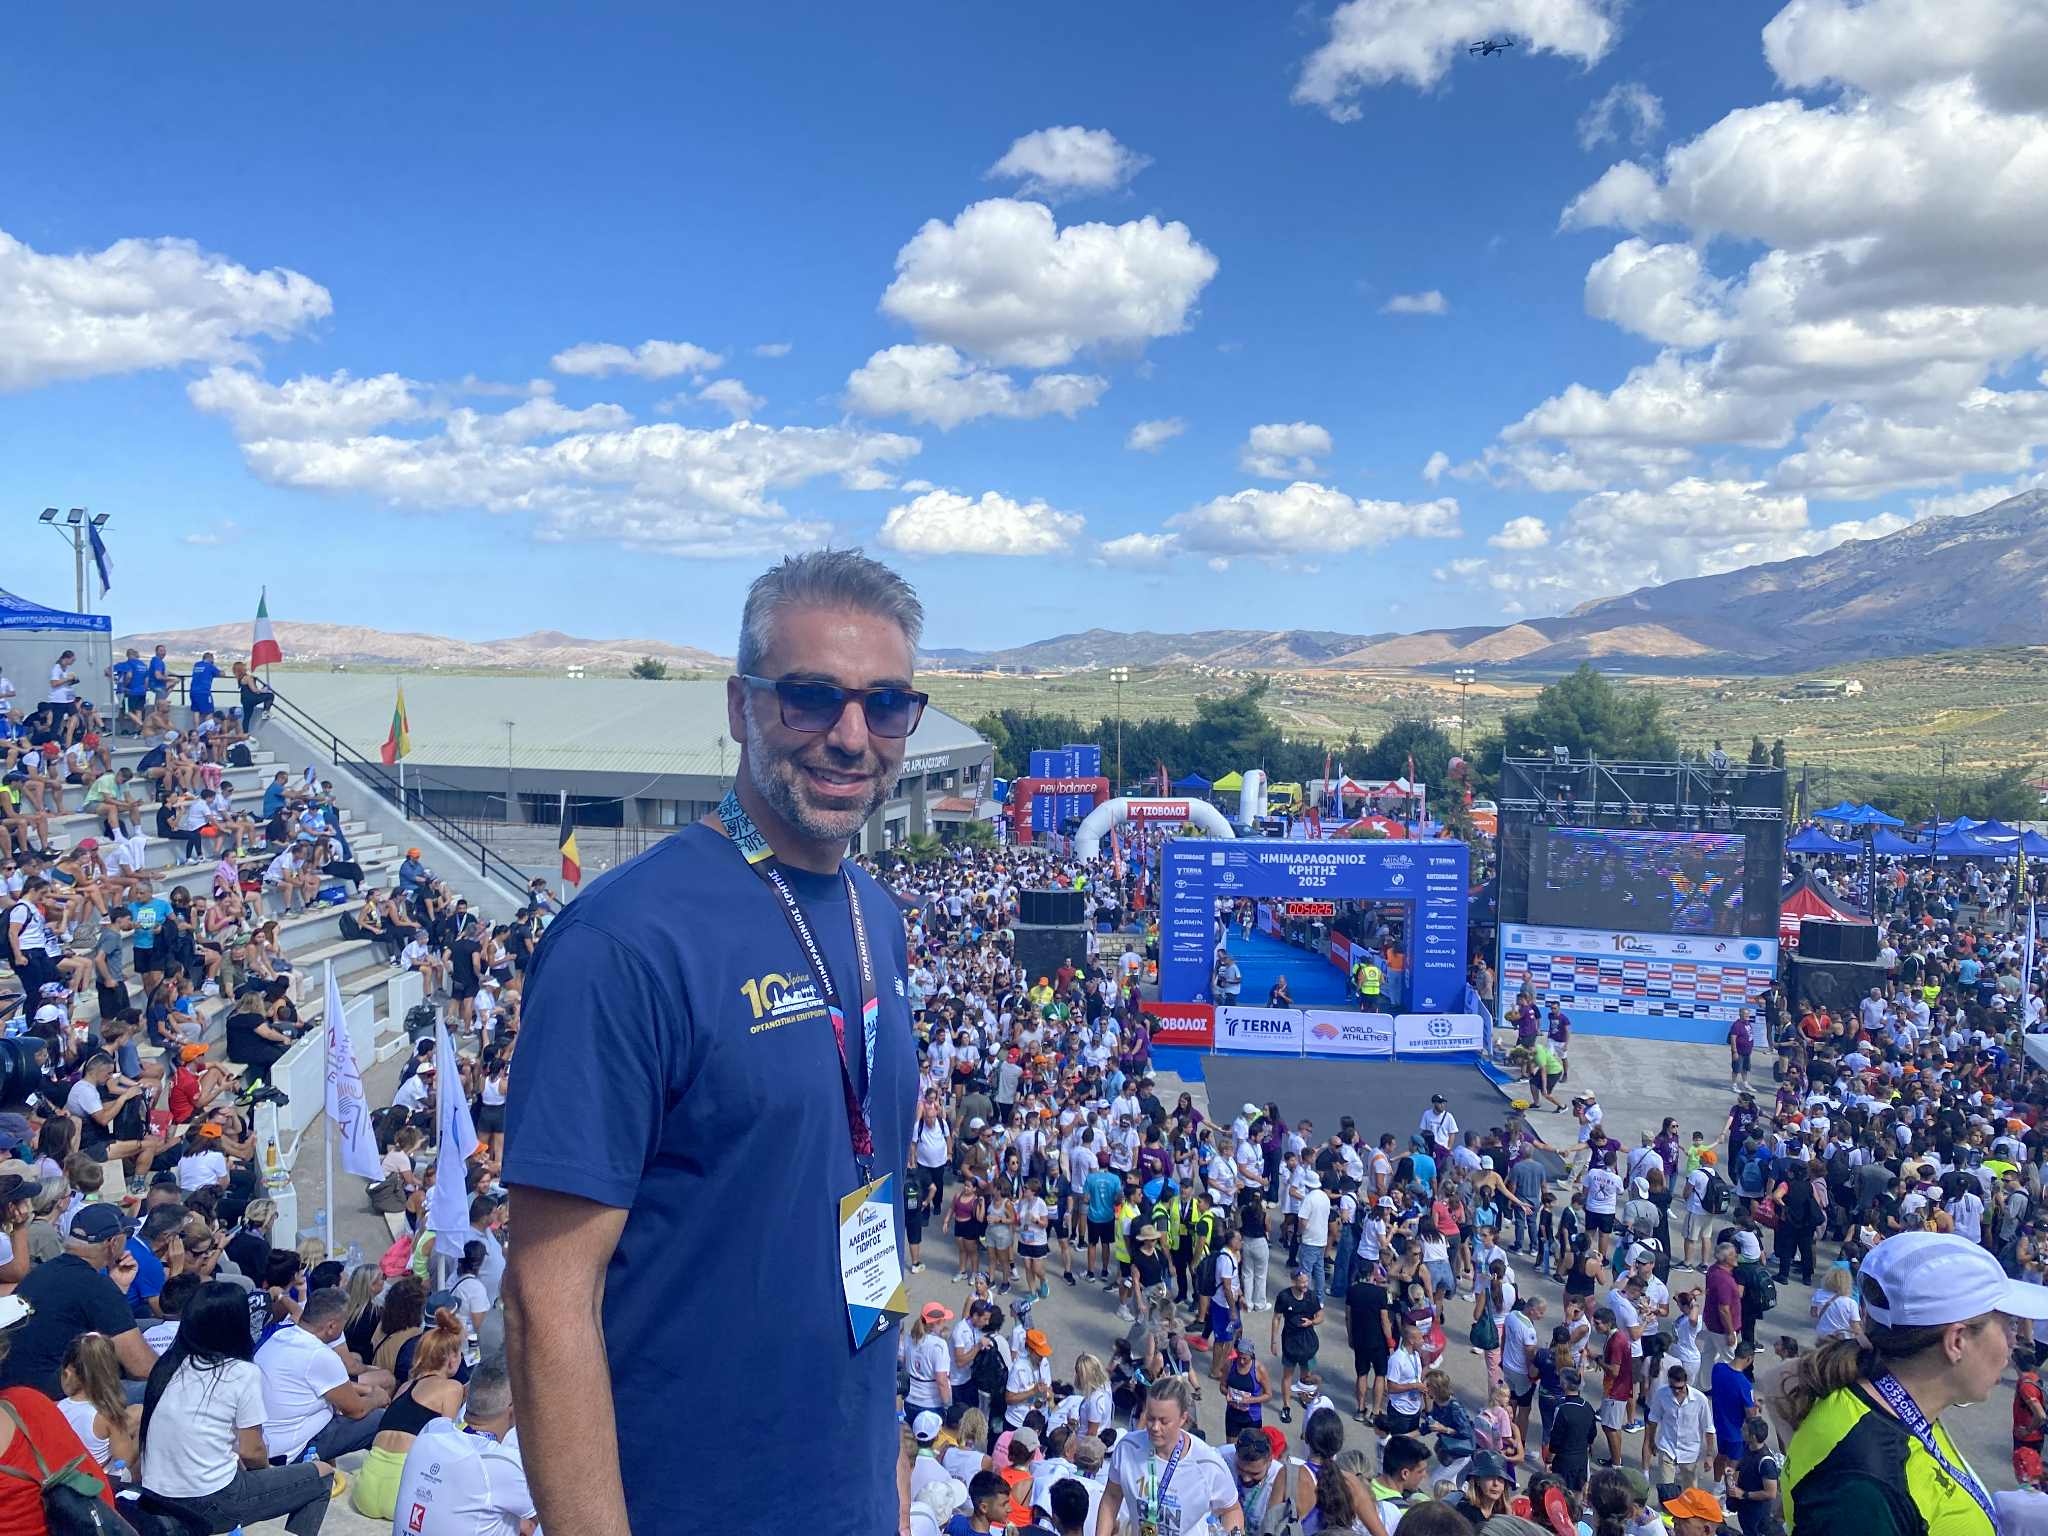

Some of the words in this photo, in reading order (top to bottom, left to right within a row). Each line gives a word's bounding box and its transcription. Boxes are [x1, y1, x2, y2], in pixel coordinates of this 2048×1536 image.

[1259, 853, 1367, 865] ΗΜΙΜΑΡΑΘΩΝΙΟΣ
[1288, 865, 1337, 876] ΚΡΗΤΗΣ
[768, 868, 796, 907] ΚΡΗΤΗΣ
[1298, 876, 1327, 887] 2025
[791, 907, 834, 996] ΗΜΙΜΑΡΑΘΩΝΙΟΣ
[855, 918, 872, 982] ΟΡΓΑΝΩΤΙΚΗ
[740, 973, 791, 1019] 10
[1160, 1017, 1207, 1032] ΟΒΟΛΟΣ
[1241, 1019, 1292, 1033] TERNA
[1342, 1026, 1373, 1035] WORLD
[1342, 1033, 1389, 1042] ATHLETICS
[1880, 1375, 1922, 1426] KNOSSOS
